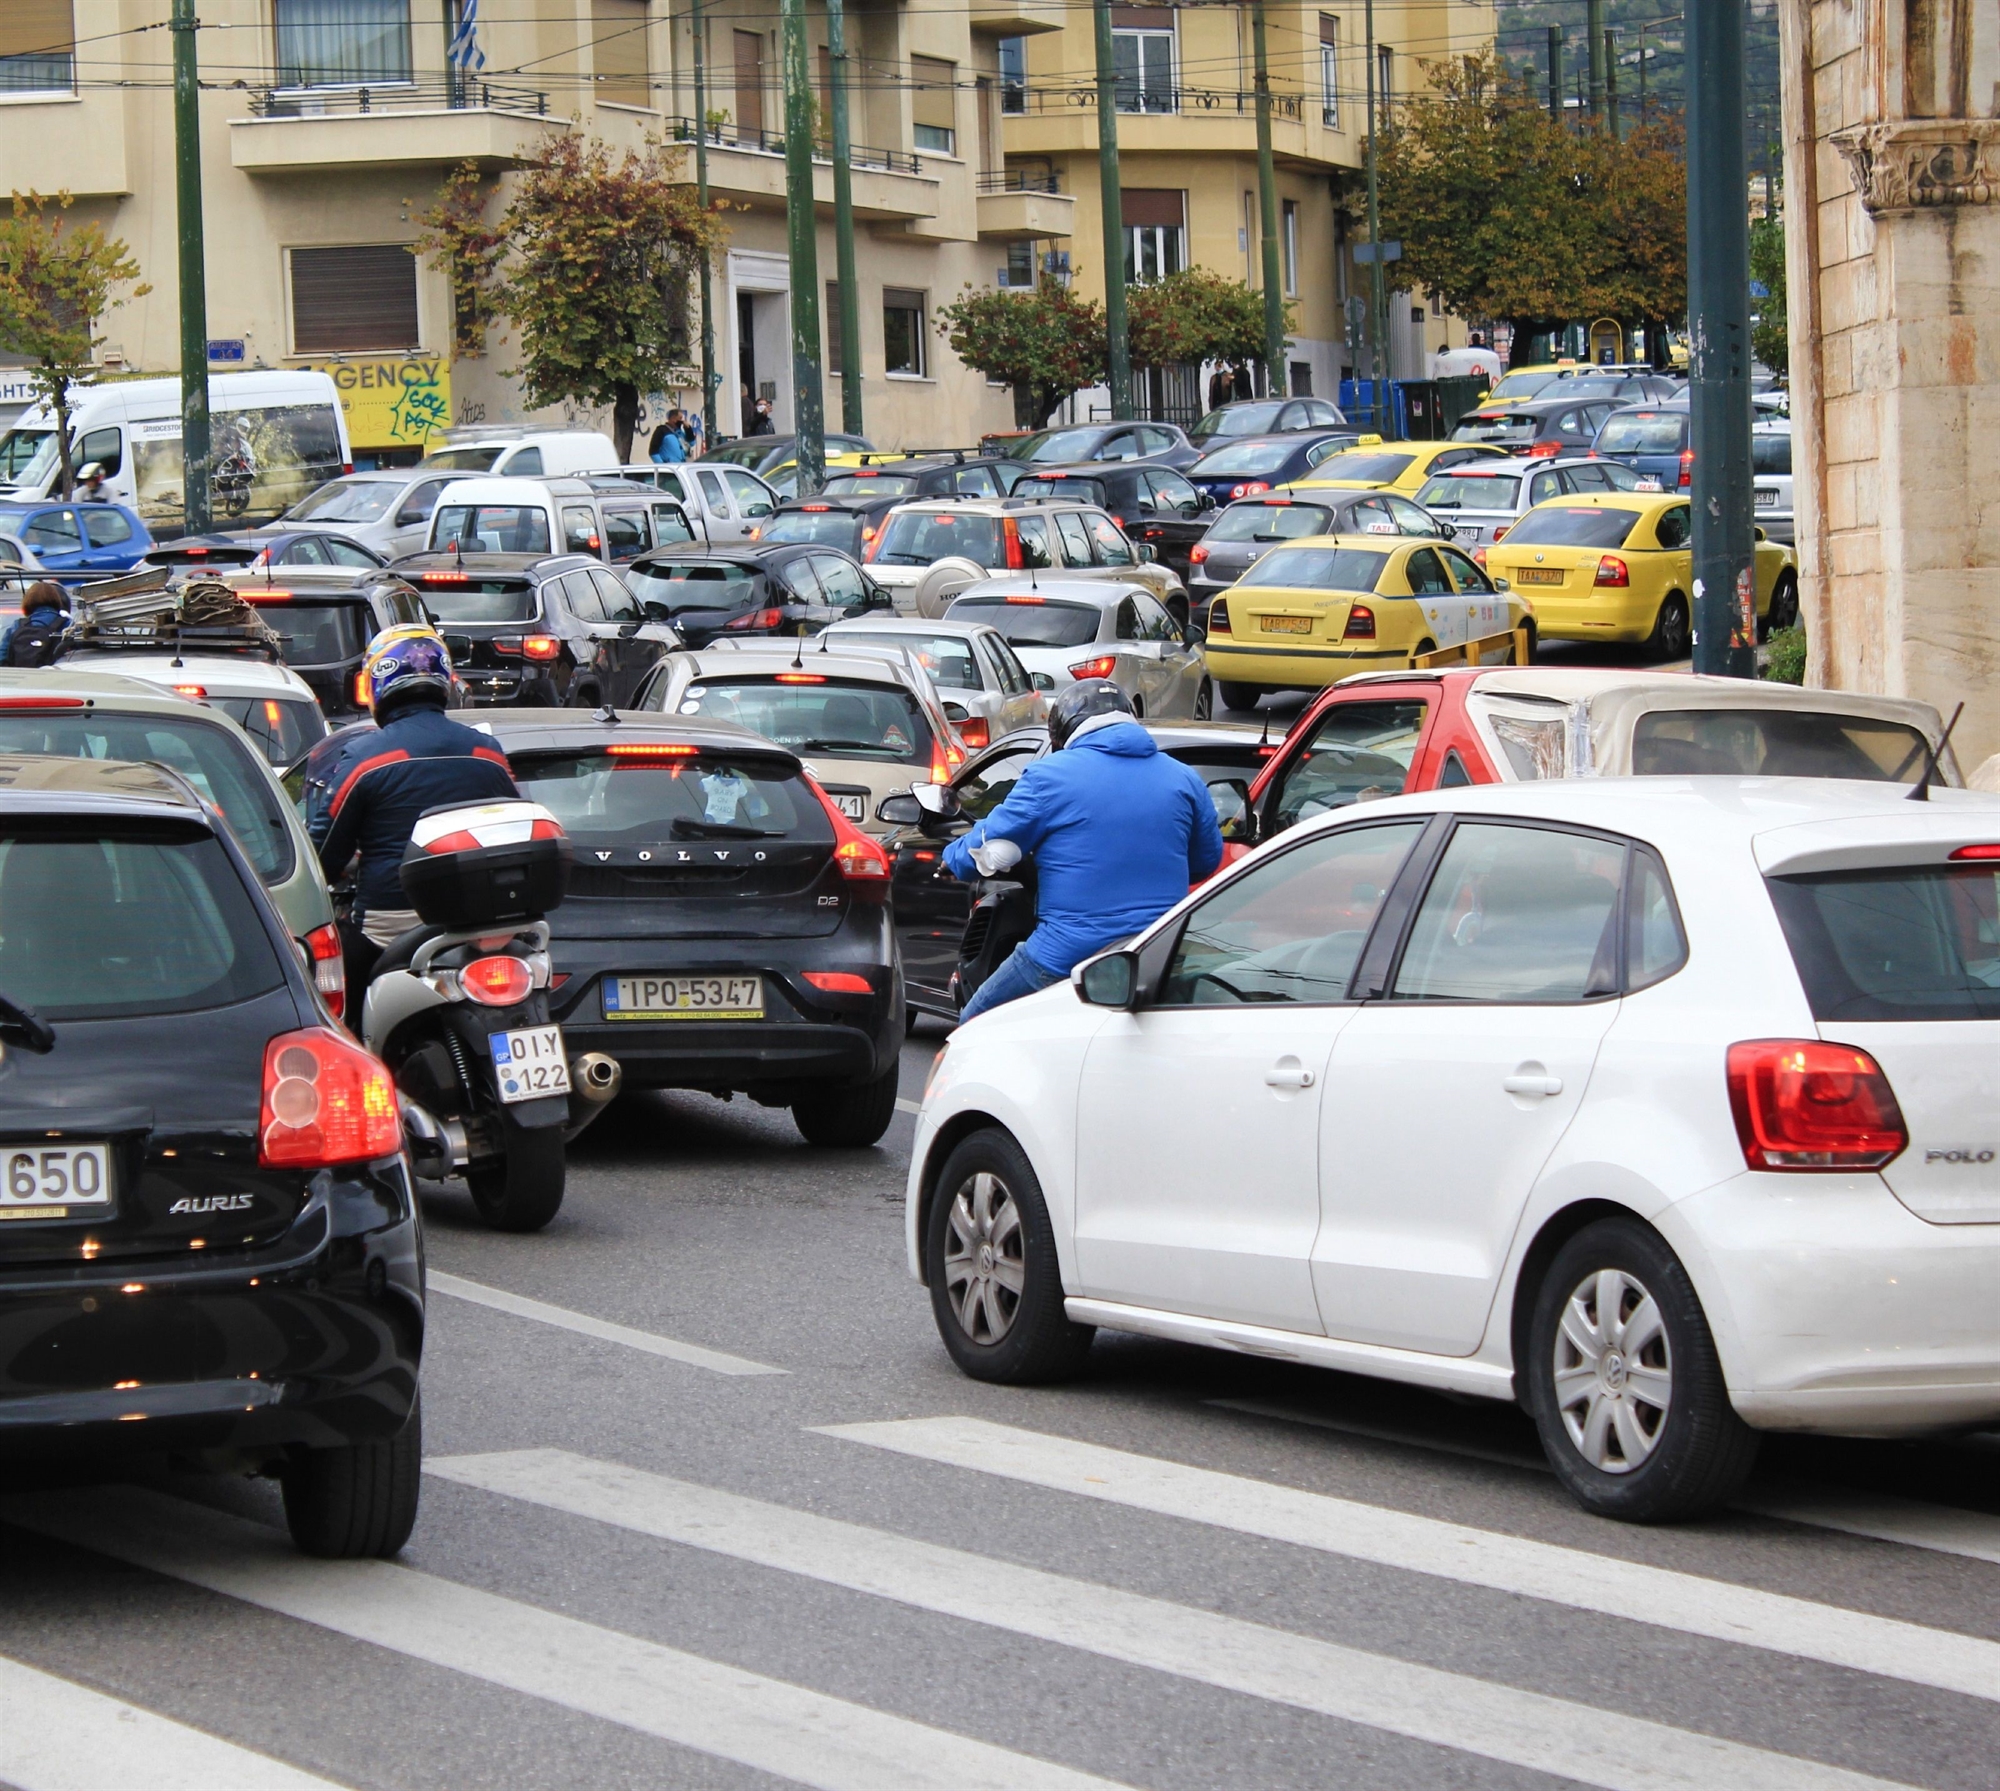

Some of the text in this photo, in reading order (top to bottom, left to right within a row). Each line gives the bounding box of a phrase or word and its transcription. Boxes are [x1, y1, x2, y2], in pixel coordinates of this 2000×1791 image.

[320, 362, 440, 390] GENCY
[838, 797, 858, 815] 41
[817, 896, 839, 906] D2
[605, 997, 618, 1005] GR
[1925, 1148, 1995, 1165] POLO
[8, 1151, 100, 1199] 650
[169, 1194, 253, 1215] AURIS
